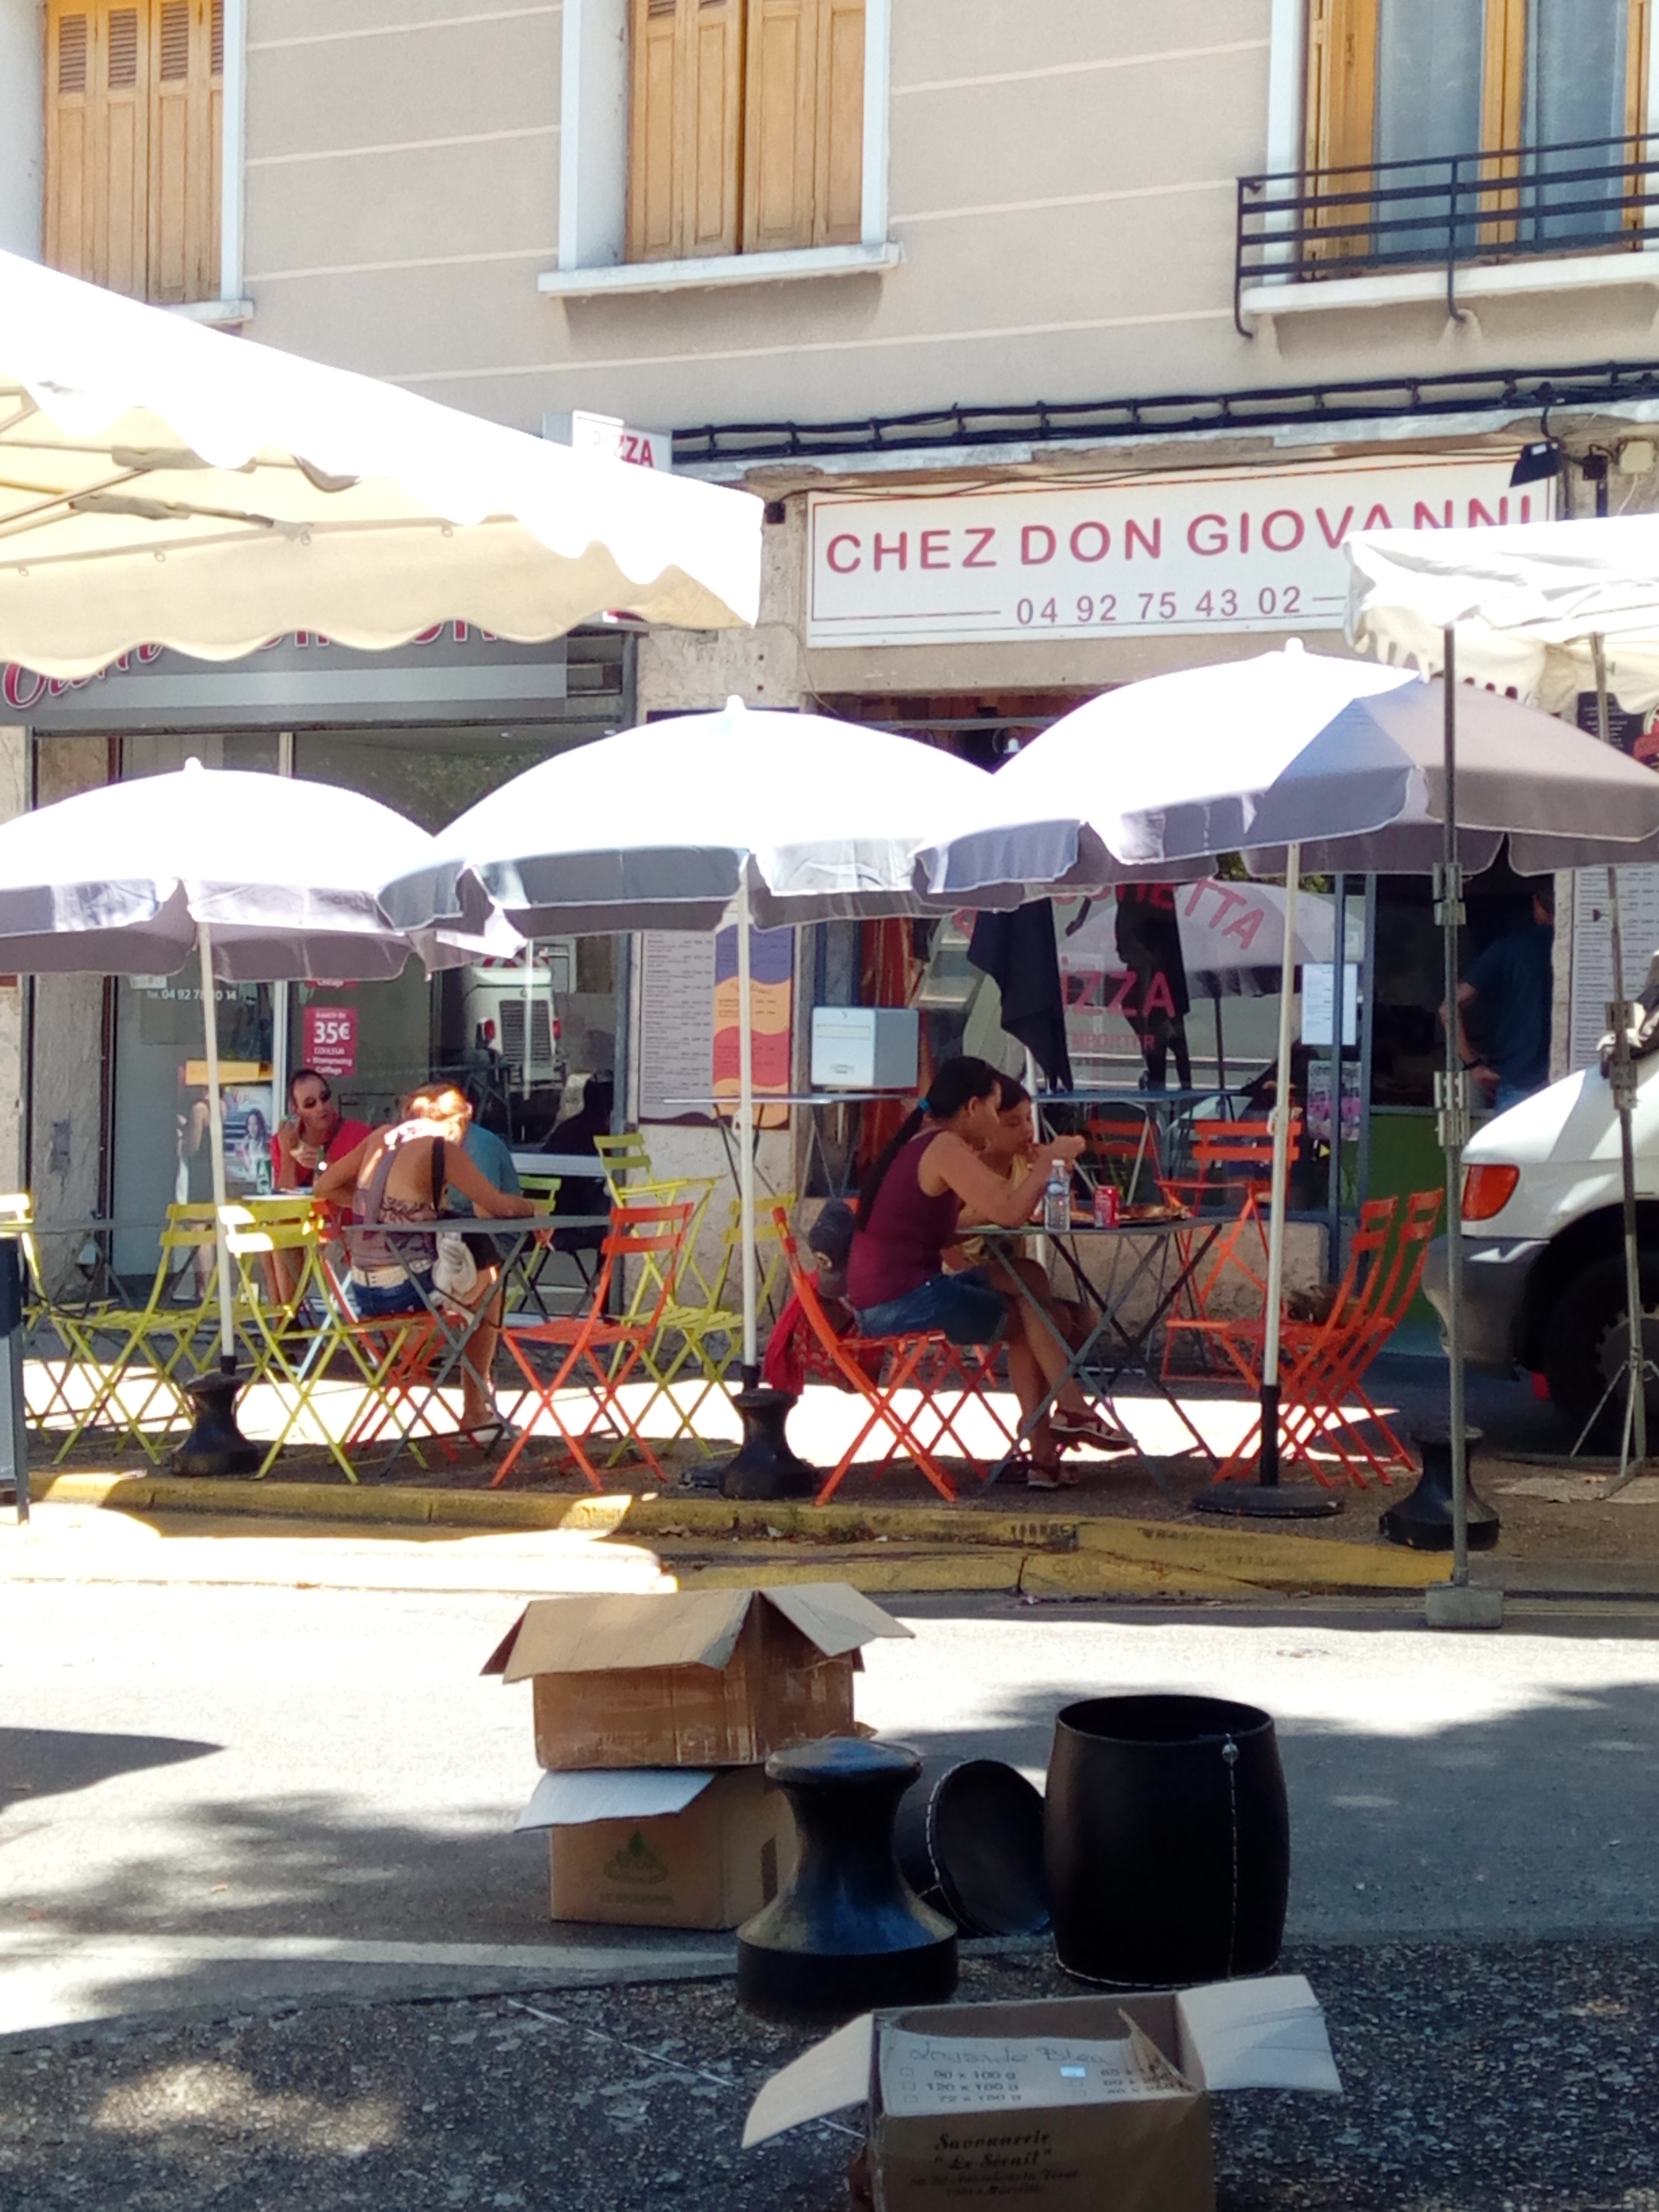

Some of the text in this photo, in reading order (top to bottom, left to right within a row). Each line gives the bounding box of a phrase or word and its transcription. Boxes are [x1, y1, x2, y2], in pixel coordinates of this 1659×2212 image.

[826, 494, 1531, 573] CHEZ DON GIOVANNI
[1017, 585, 1302, 625] 04 92 75 43 02
[162, 989, 175, 1000] 04
[177, 989, 191, 1000] 92
[314, 1020, 350, 1044] 35€
